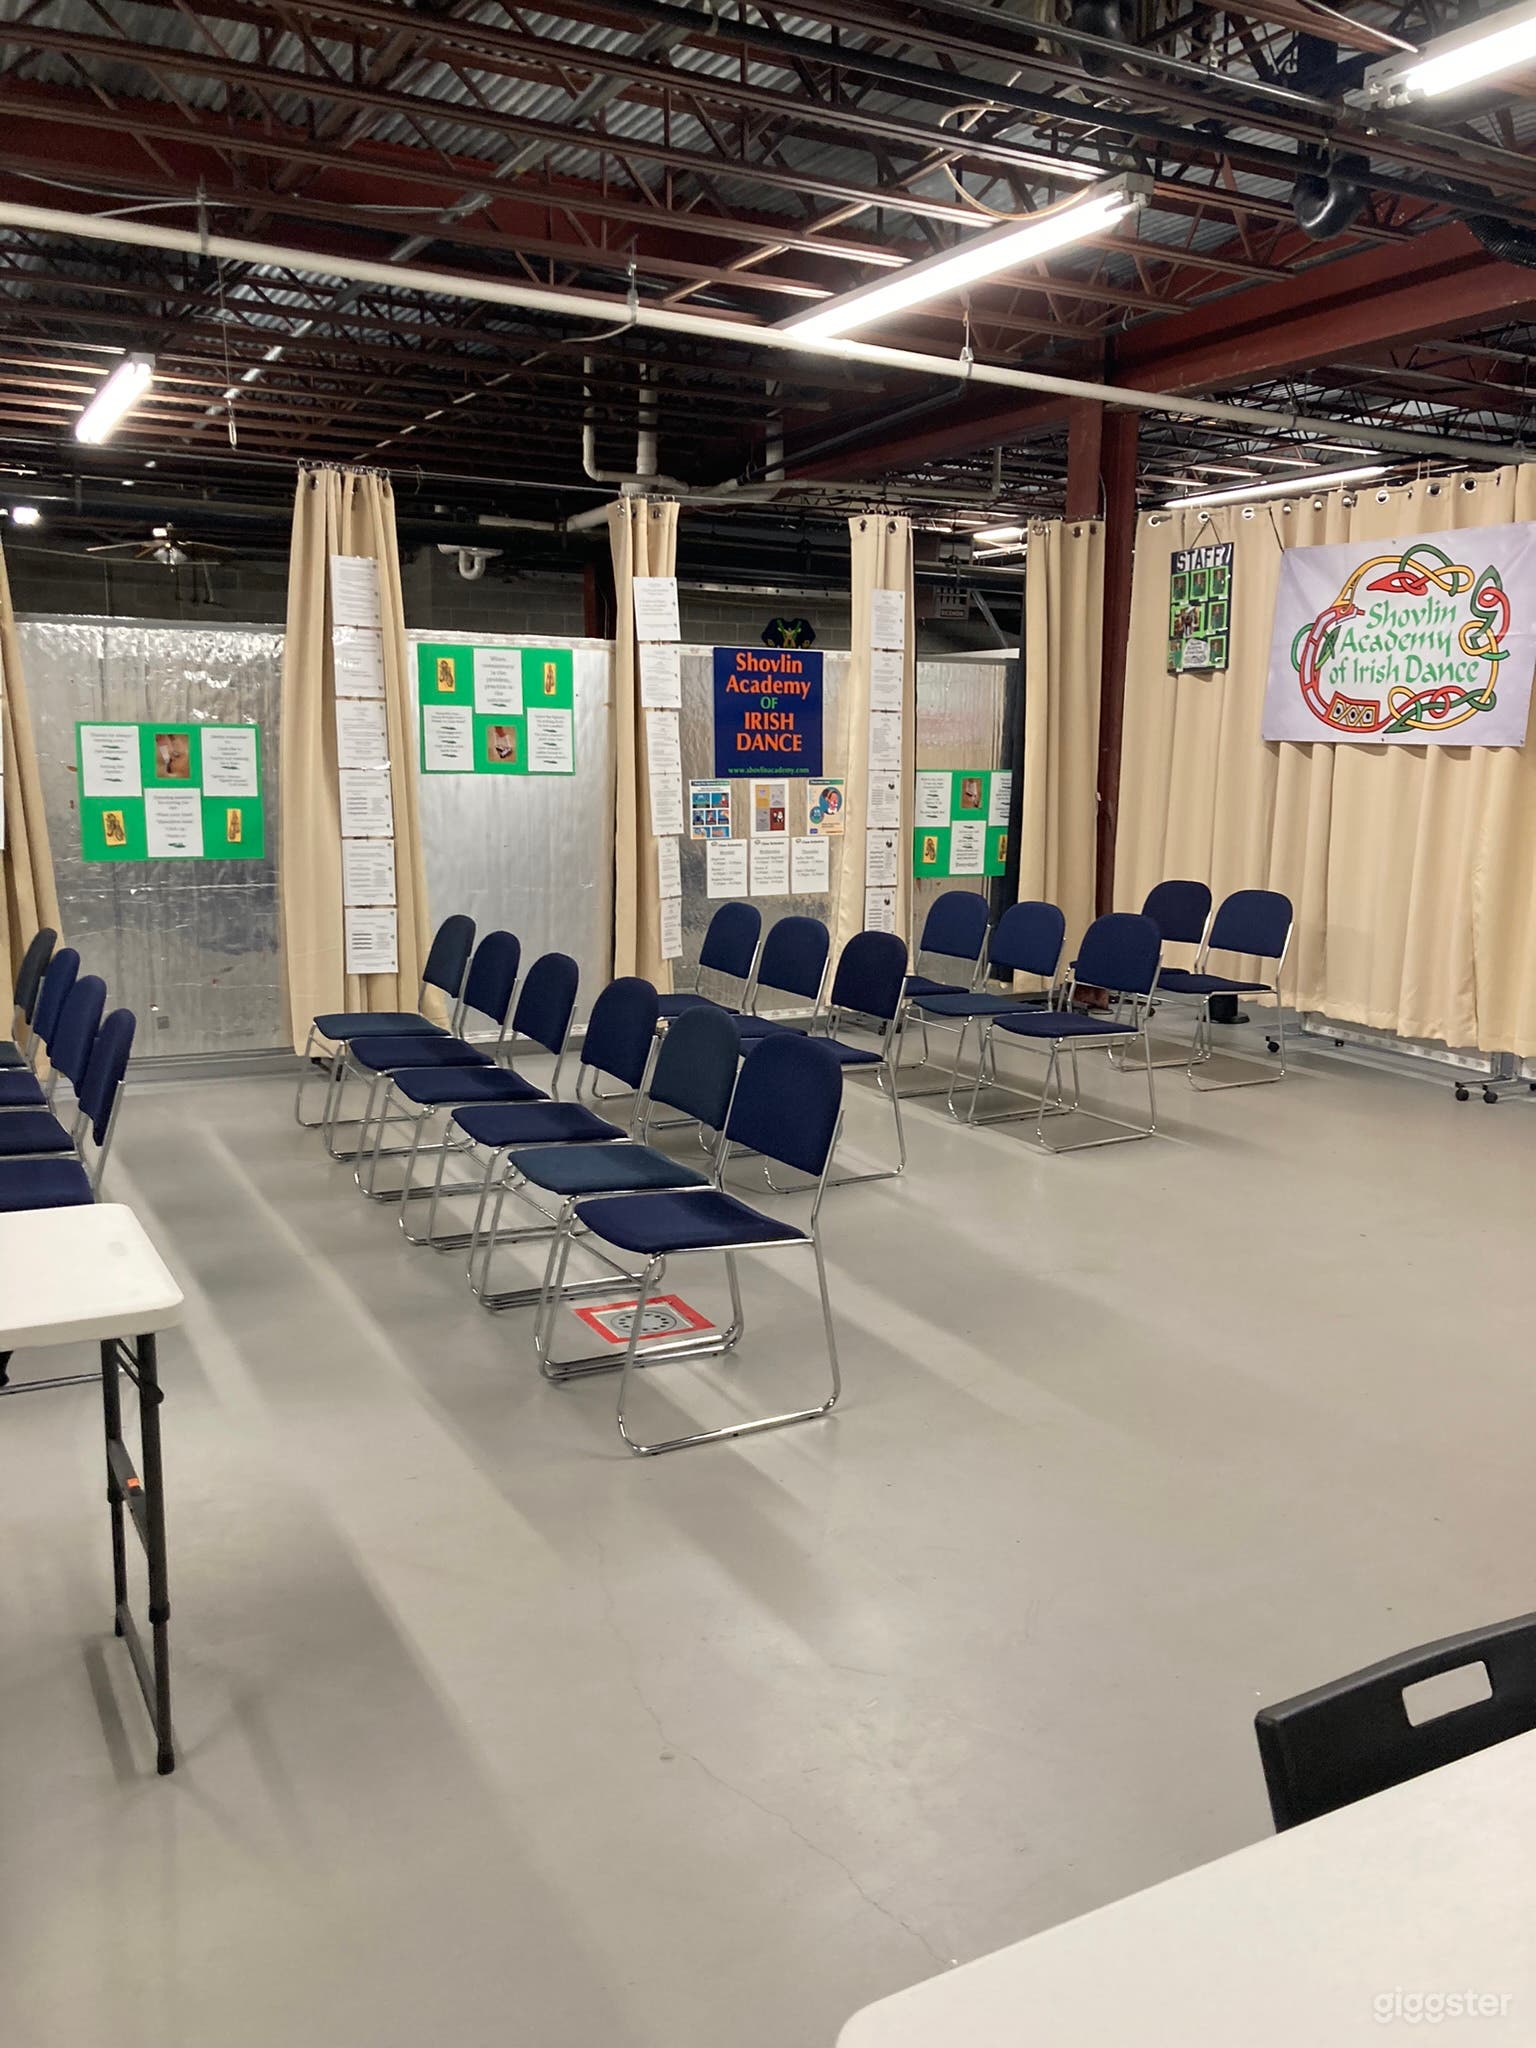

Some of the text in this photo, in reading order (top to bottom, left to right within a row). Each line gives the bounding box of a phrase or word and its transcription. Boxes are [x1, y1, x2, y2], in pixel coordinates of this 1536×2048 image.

[1177, 547, 1225, 572] STAFF
[1367, 597, 1456, 629] Shovlin
[1340, 628, 1452, 657] Academy
[736, 652, 803, 673] Shovlin
[1329, 655, 1479, 684] of Irish Dance
[726, 674, 811, 700] Academy
[760, 696, 778, 709] OF
[744, 711, 794, 730] IRISH
[736, 732, 802, 752] DANCE
